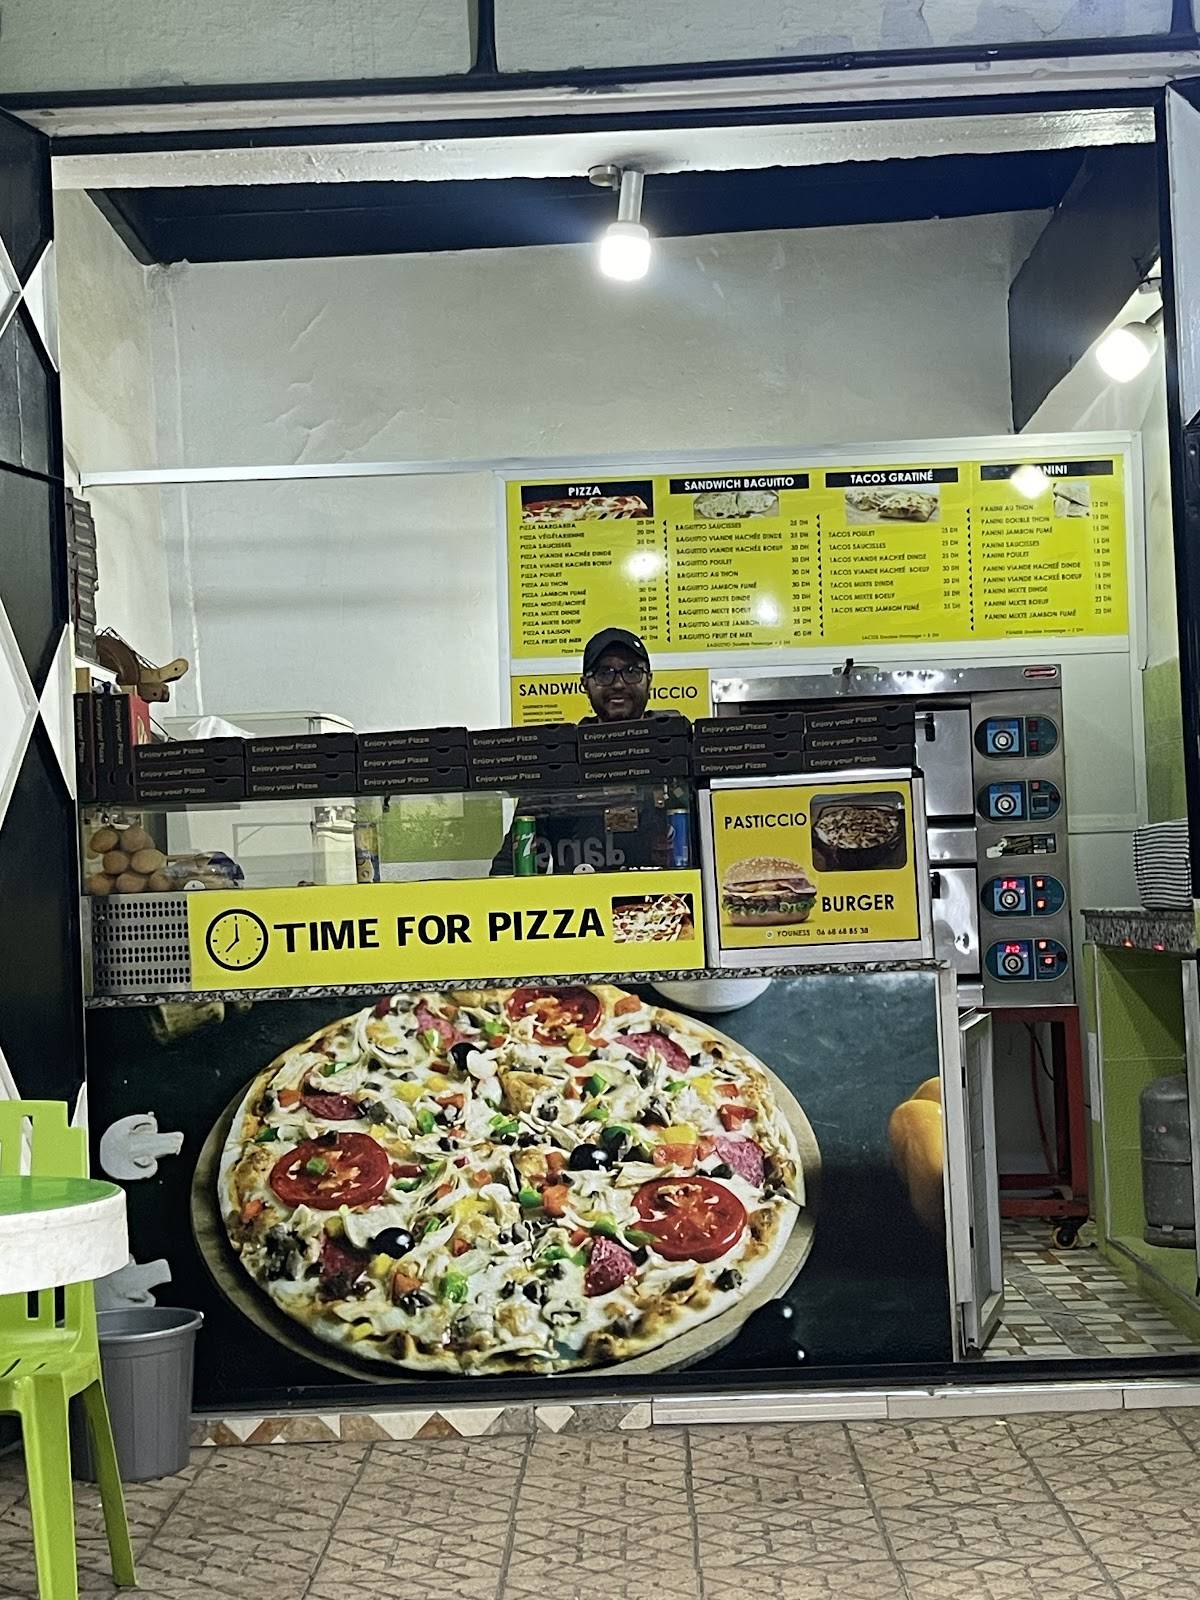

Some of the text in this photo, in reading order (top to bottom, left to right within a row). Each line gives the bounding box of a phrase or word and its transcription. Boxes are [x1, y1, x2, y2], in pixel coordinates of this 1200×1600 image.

[1036, 466, 1068, 476] ANINI
[851, 469, 933, 484] TACOS GRATINÉ
[684, 477, 794, 490] SANDWICH BAGUITTO
[568, 486, 601, 496] PIZZA
[520, 682, 588, 696] SANDWIC
[584, 728, 649, 741] Enjoy your Pizza
[473, 738, 496, 746] Enjoy
[516, 734, 538, 742] Pizza
[812, 735, 878, 747] Enjoy your Pizza
[296, 742, 317, 750] Pizza
[139, 751, 162, 759] Enjoy
[584, 751, 607, 759] Enjoy
[628, 747, 650, 755] Pizza
[407, 756, 429, 764] Pizza
[473, 757, 495, 765] Enjoy
[496, 756, 515, 764] your
[854, 755, 876, 763] Pizza
[296, 762, 317, 770] Pizza
[140, 770, 162, 778] Enjoy
[476, 775, 498, 783] Enjoy
[364, 778, 386, 786] Enjoy
[140, 789, 163, 797] Enjoy
[253, 784, 275, 792] Enjoy
[724, 813, 807, 829] PASTICCIO
[822, 894, 894, 912] BURGER
[274, 907, 604, 953] TIME FOR PIZZA
